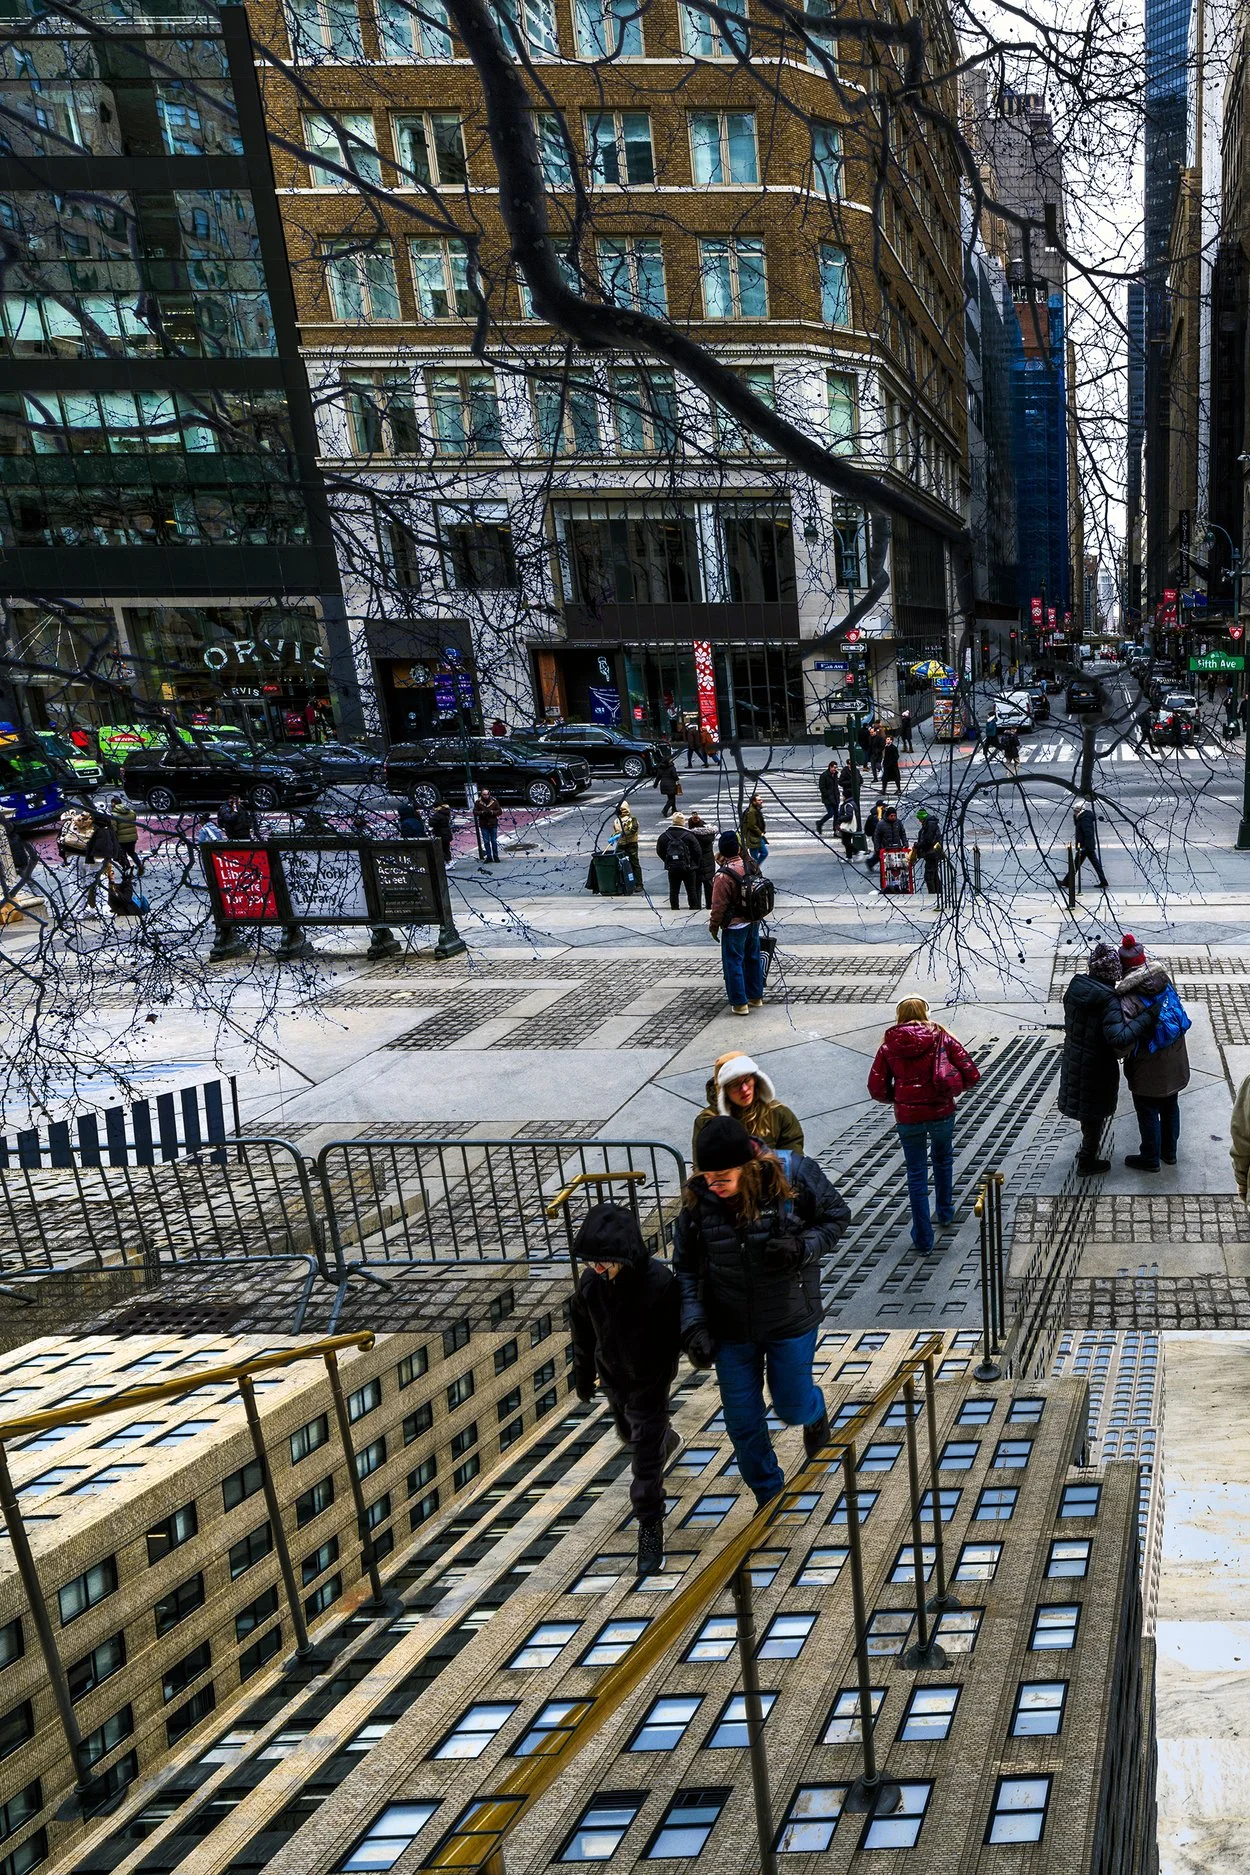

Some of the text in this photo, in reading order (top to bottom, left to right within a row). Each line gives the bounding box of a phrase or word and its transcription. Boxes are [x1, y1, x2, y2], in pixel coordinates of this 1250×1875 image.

[203, 639, 328, 670] ORVIS
[1220, 660, 1236, 668] Ave
[221, 687, 260, 698] RVIS
[216, 856, 240, 868] The
[399, 856, 411, 864] Us
[290, 881, 329, 892] ublic
